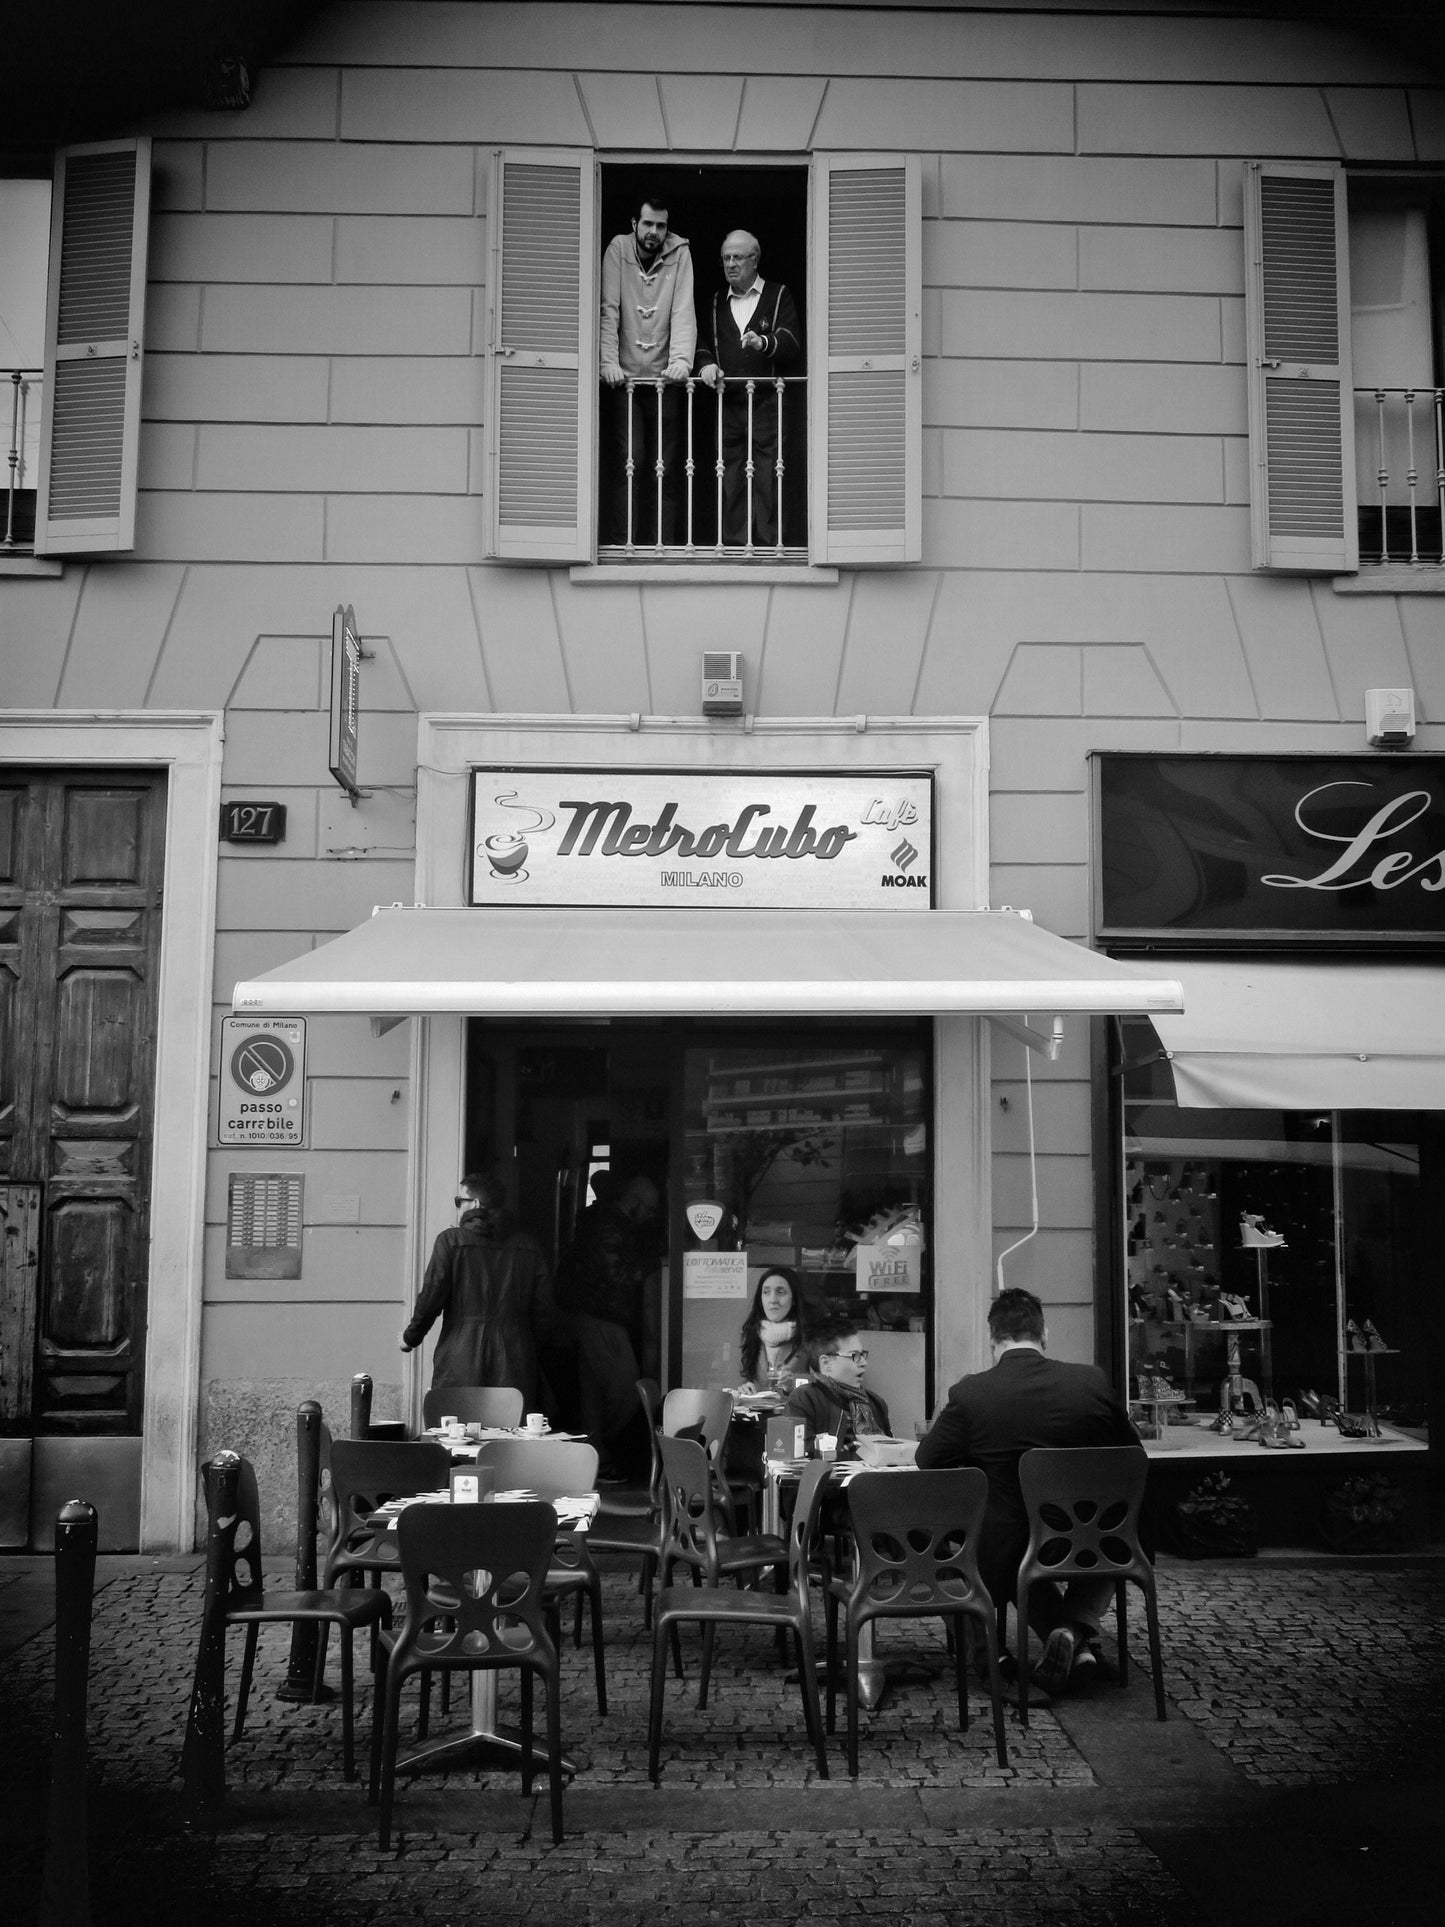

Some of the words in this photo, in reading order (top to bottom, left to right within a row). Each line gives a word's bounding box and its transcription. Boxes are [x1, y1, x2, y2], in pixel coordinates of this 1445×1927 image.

[230, 807, 273, 835] 127
[556, 801, 858, 858] MetroCubo
[660, 871, 744, 887] MILANO
[881, 874, 927, 888] MOAK
[230, 1021, 260, 1029] Comune
[263, 1021, 270, 1029] di
[240, 1102, 283, 1114] passo
[228, 1117, 294, 1130] carrabile
